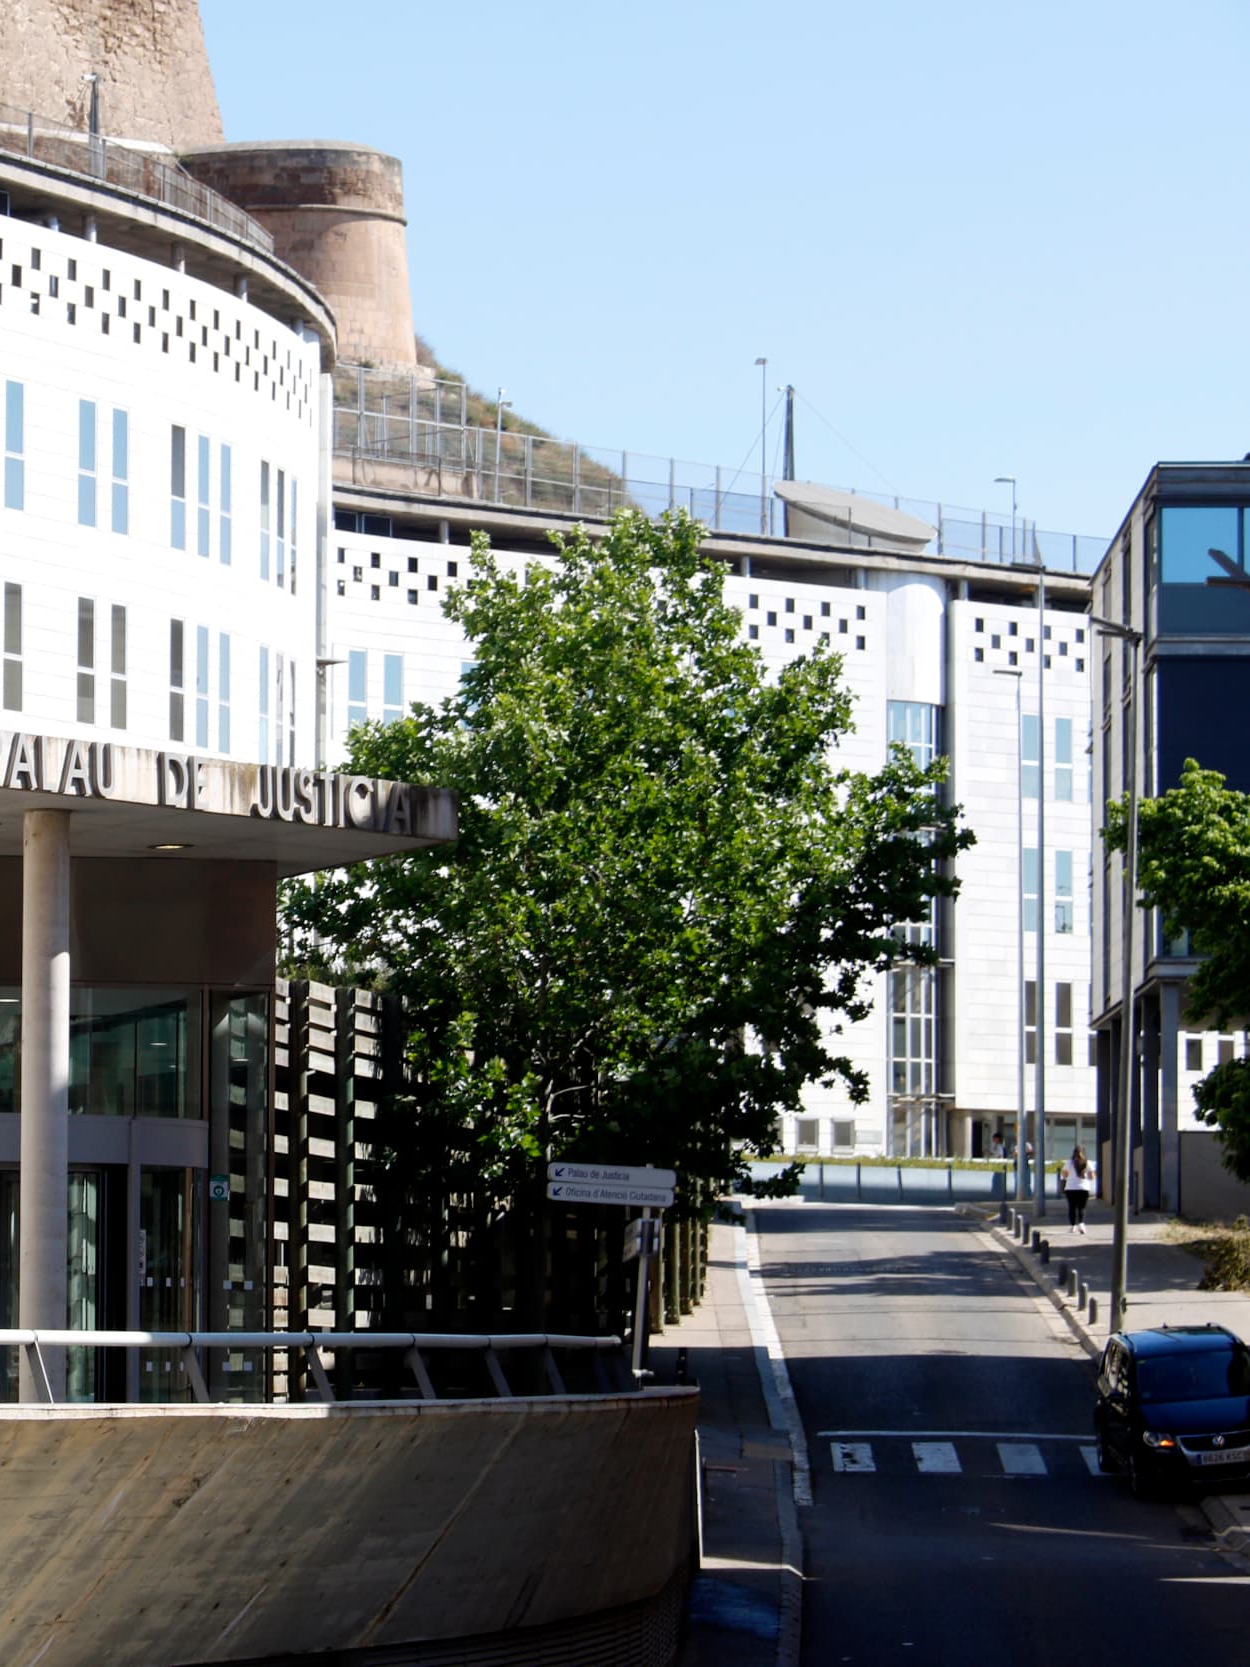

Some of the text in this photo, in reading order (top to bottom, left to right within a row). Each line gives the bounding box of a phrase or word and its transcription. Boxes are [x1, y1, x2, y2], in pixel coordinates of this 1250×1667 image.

[156, 751, 211, 811] DE
[568, 1168, 588, 1178] Palau
[590, 1169, 600, 1179] de
[565, 1187, 591, 1198] Oficina
[629, 1191, 666, 1202] Ciutadana
